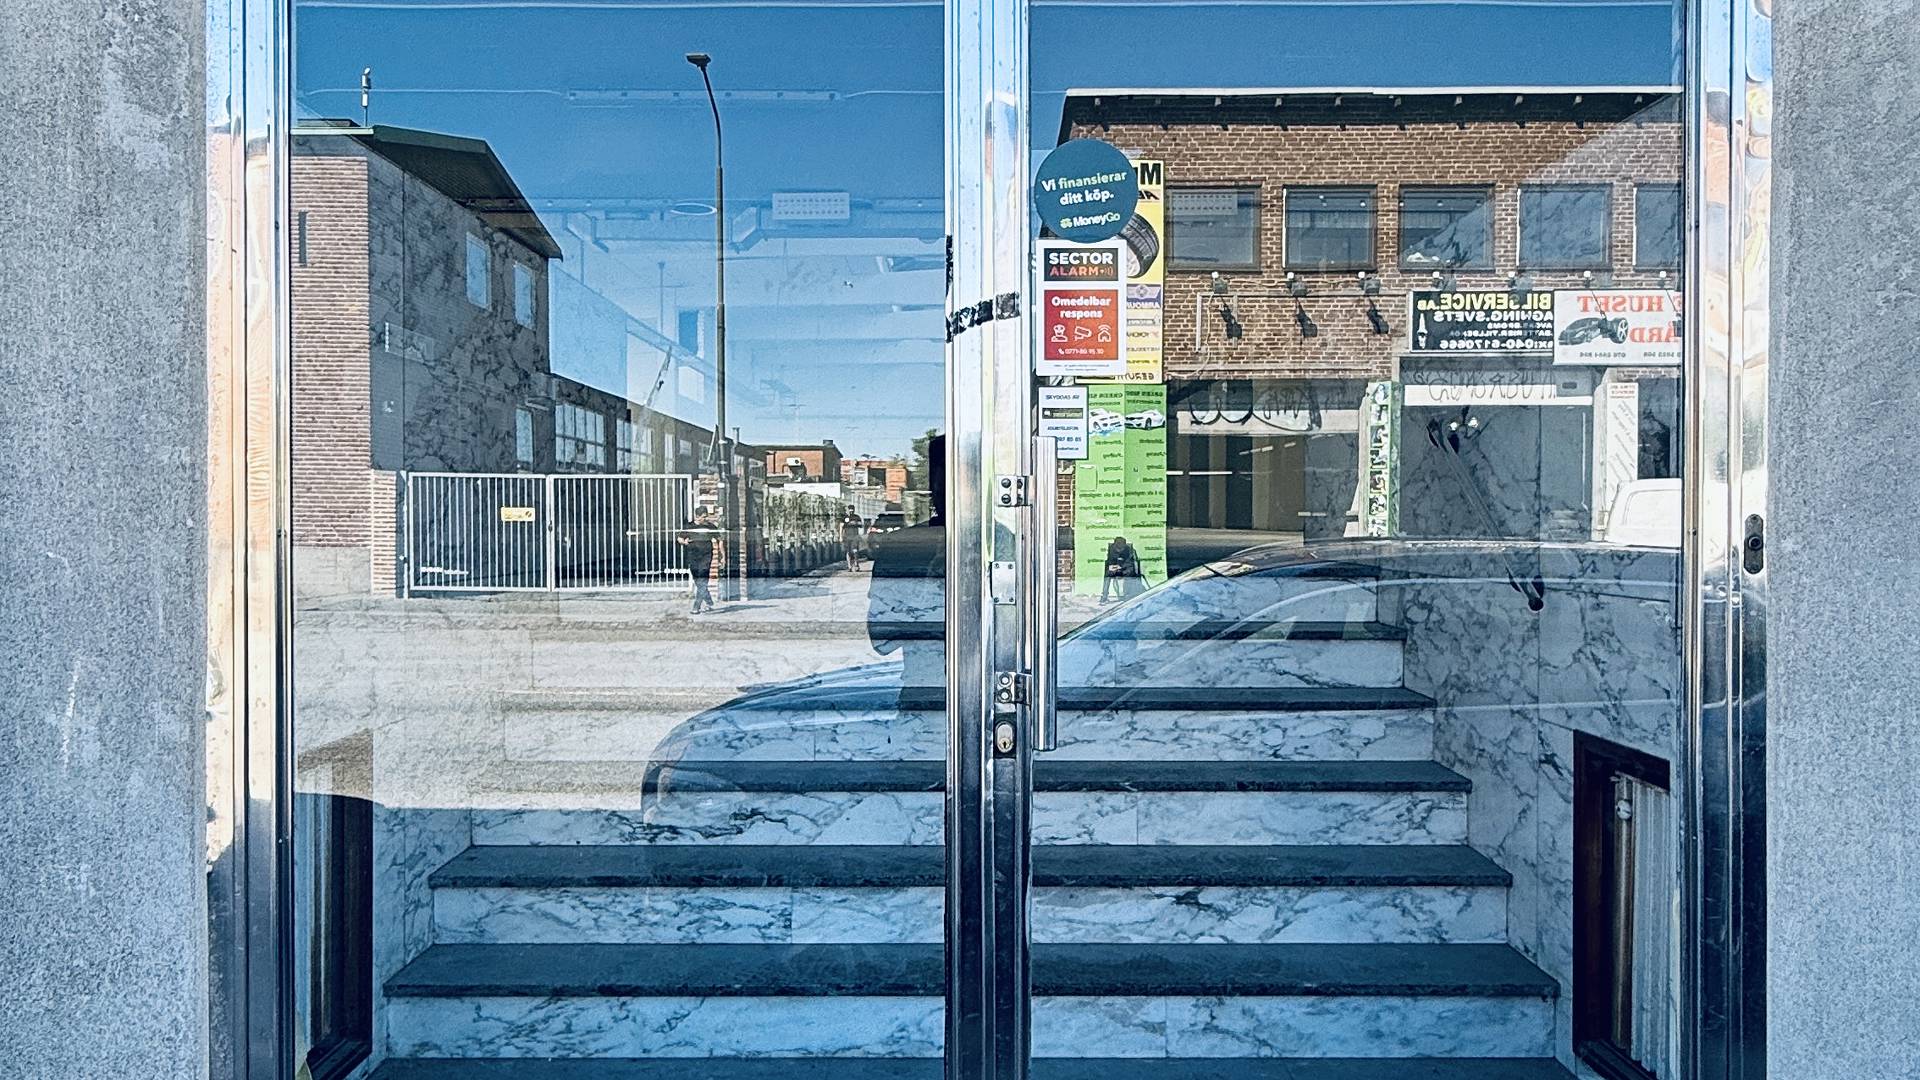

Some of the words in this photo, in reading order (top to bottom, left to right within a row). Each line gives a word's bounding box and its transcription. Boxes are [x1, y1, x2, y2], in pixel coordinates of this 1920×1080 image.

[1041, 179, 1057, 192] Vi
[1058, 172, 1127, 189] finansierar
[1060, 192, 1083, 205] ditt
[1085, 188, 1114, 203] köp.
[1074, 211, 1120, 227] MoneyGo
[1049, 252, 1113, 265] SECTOR
[1050, 266, 1099, 276] ALARM
[1051, 296, 1112, 307] Omedelbar
[1060, 309, 1103, 320] respons
